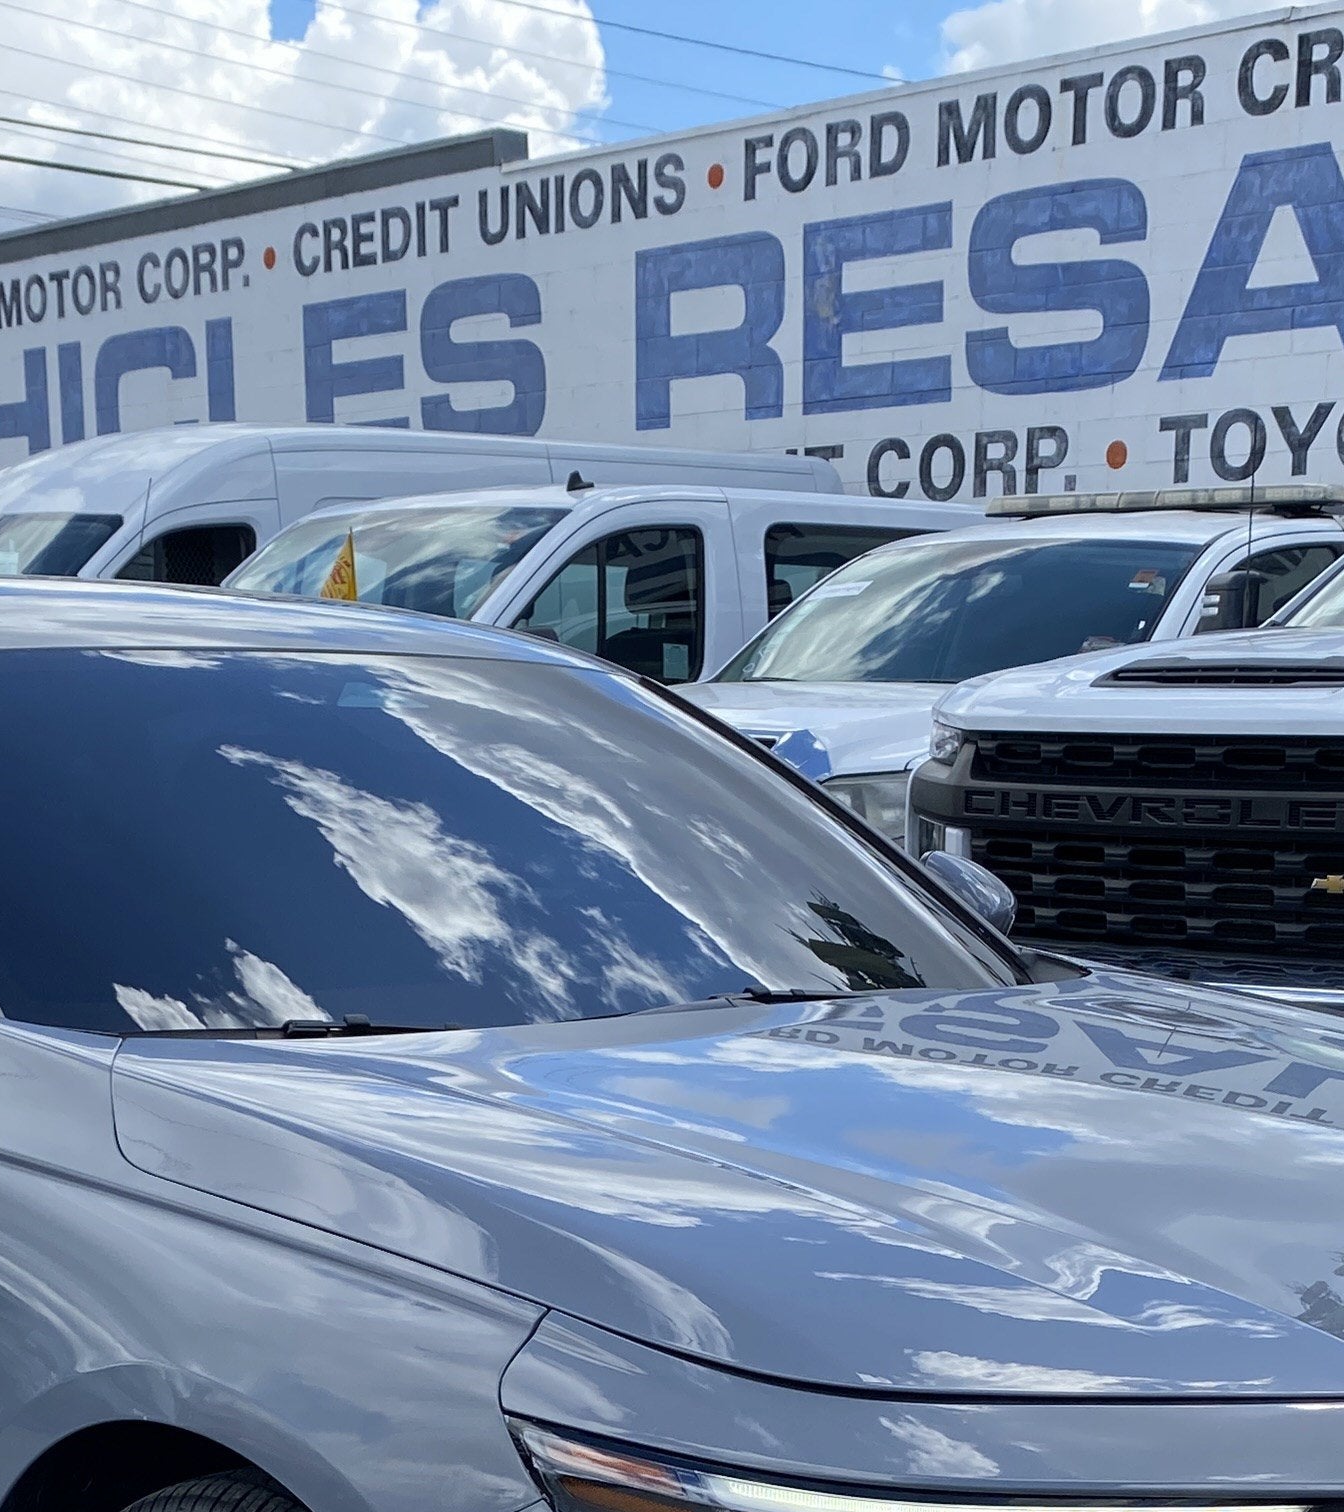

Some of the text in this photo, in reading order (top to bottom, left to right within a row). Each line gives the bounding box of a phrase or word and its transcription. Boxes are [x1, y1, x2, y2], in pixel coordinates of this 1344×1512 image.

[743, 110, 911, 201] FORD
[936, 55, 1205, 167] MOTOR
[293, 152, 686, 277] CREDIT UNIONS
[137, 237, 251, 304] CORP.
[867, 425, 1077, 502] CORP.
